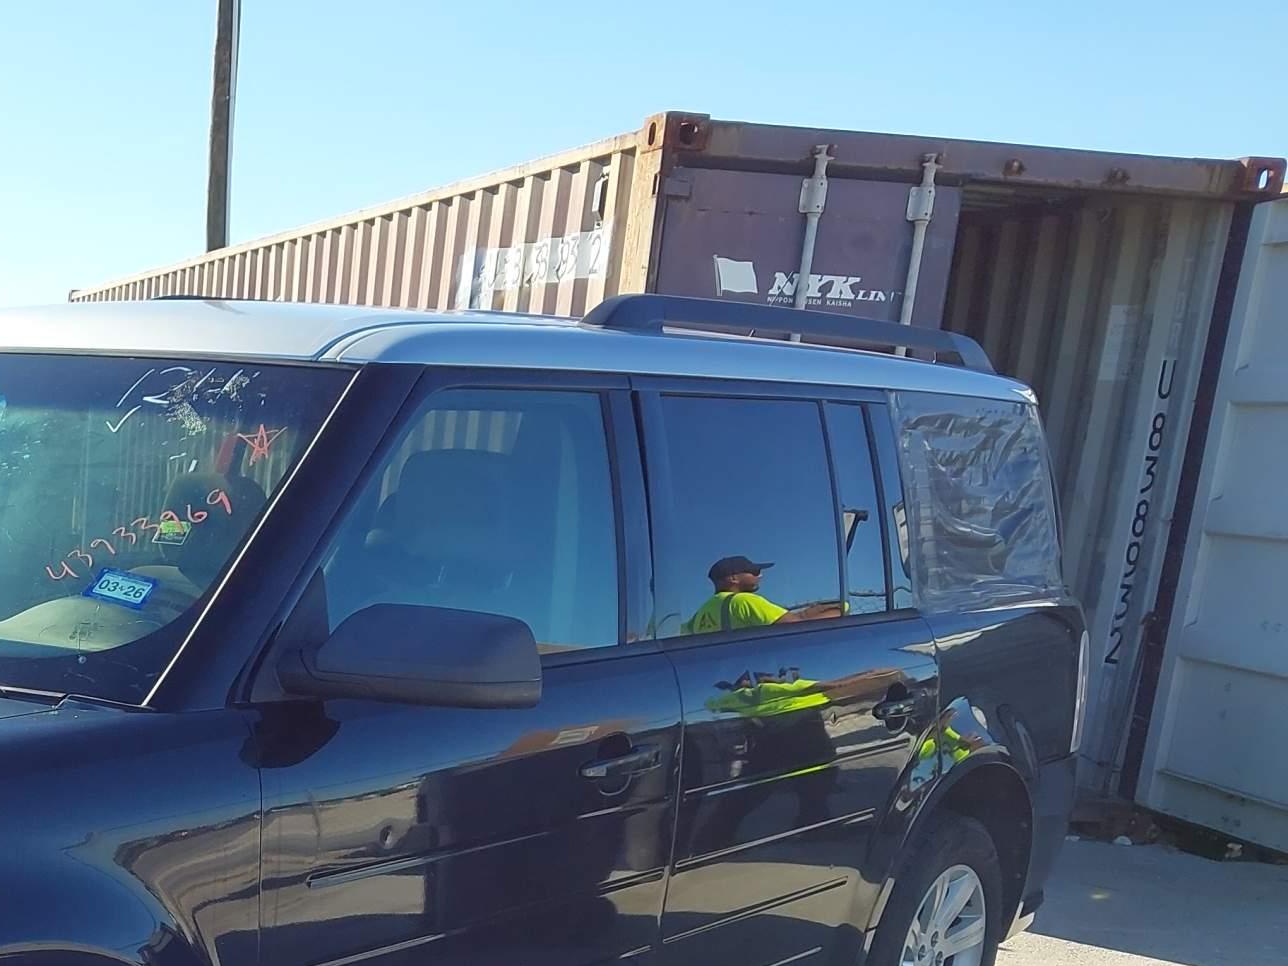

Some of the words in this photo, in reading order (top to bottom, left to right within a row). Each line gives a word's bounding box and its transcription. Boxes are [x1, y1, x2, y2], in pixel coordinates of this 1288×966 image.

[768, 272, 861, 299] NYK
[856, 290, 894, 302] LIN
[826, 299, 852, 307] KAISHA
